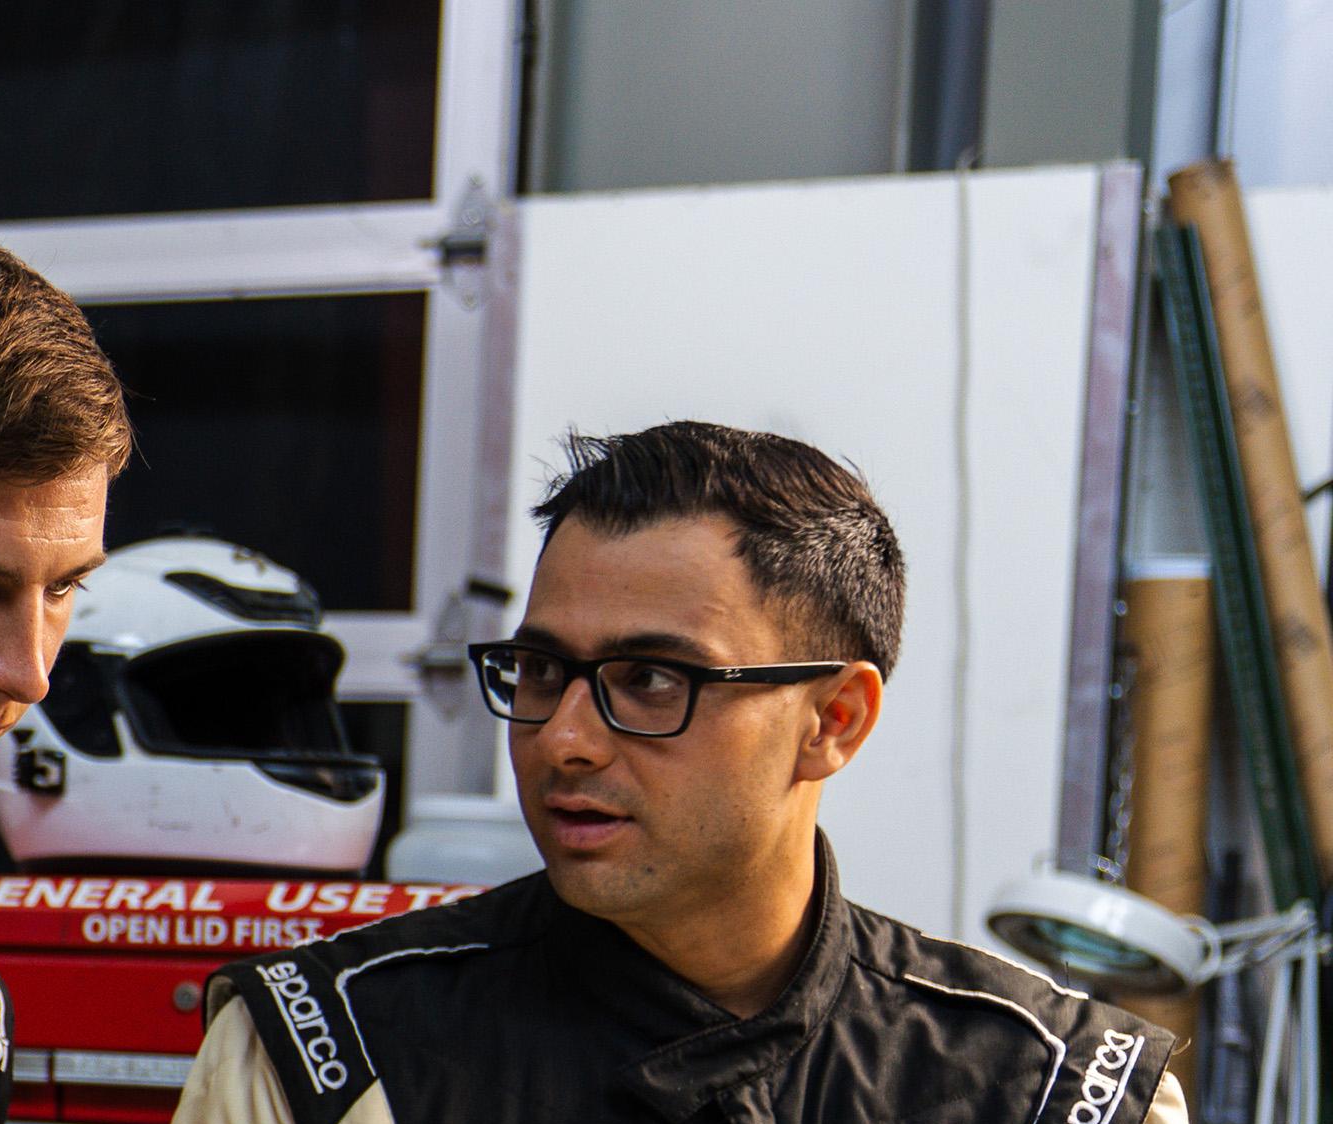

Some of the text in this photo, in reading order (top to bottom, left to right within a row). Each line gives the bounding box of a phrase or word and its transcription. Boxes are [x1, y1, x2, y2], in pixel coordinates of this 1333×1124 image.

[266, 881, 394, 914] USE
[82, 912, 324, 948] OPEN LID FIRST
[259, 960, 348, 1092] sparco
